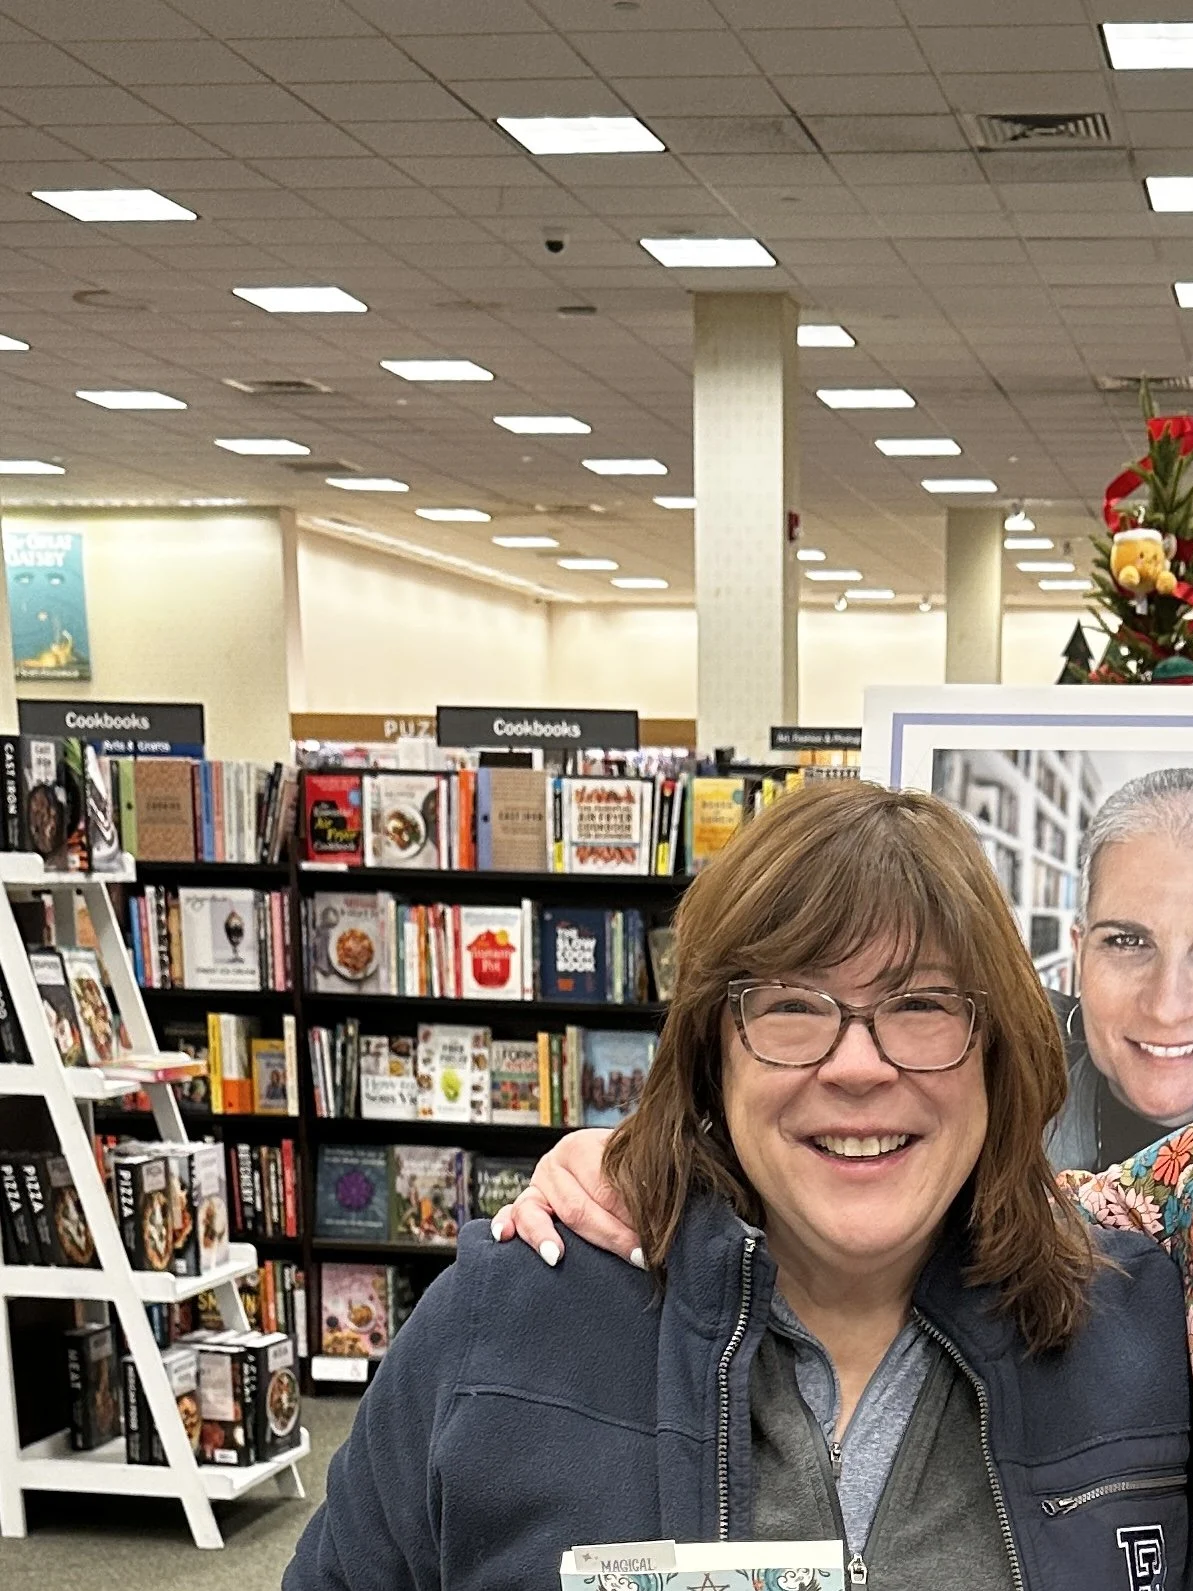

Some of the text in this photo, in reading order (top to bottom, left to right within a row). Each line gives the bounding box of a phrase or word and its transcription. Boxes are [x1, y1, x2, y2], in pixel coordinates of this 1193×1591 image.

[65, 711, 151, 730] Cookbooks
[493, 718, 582, 738] Cookbooks
[1, 1165, 22, 1214] PIZZA
[22, 1164, 44, 1214] PIZZA
[119, 1169, 135, 1218] PIZZA
[601, 1557, 655, 1573] MAGICAL
